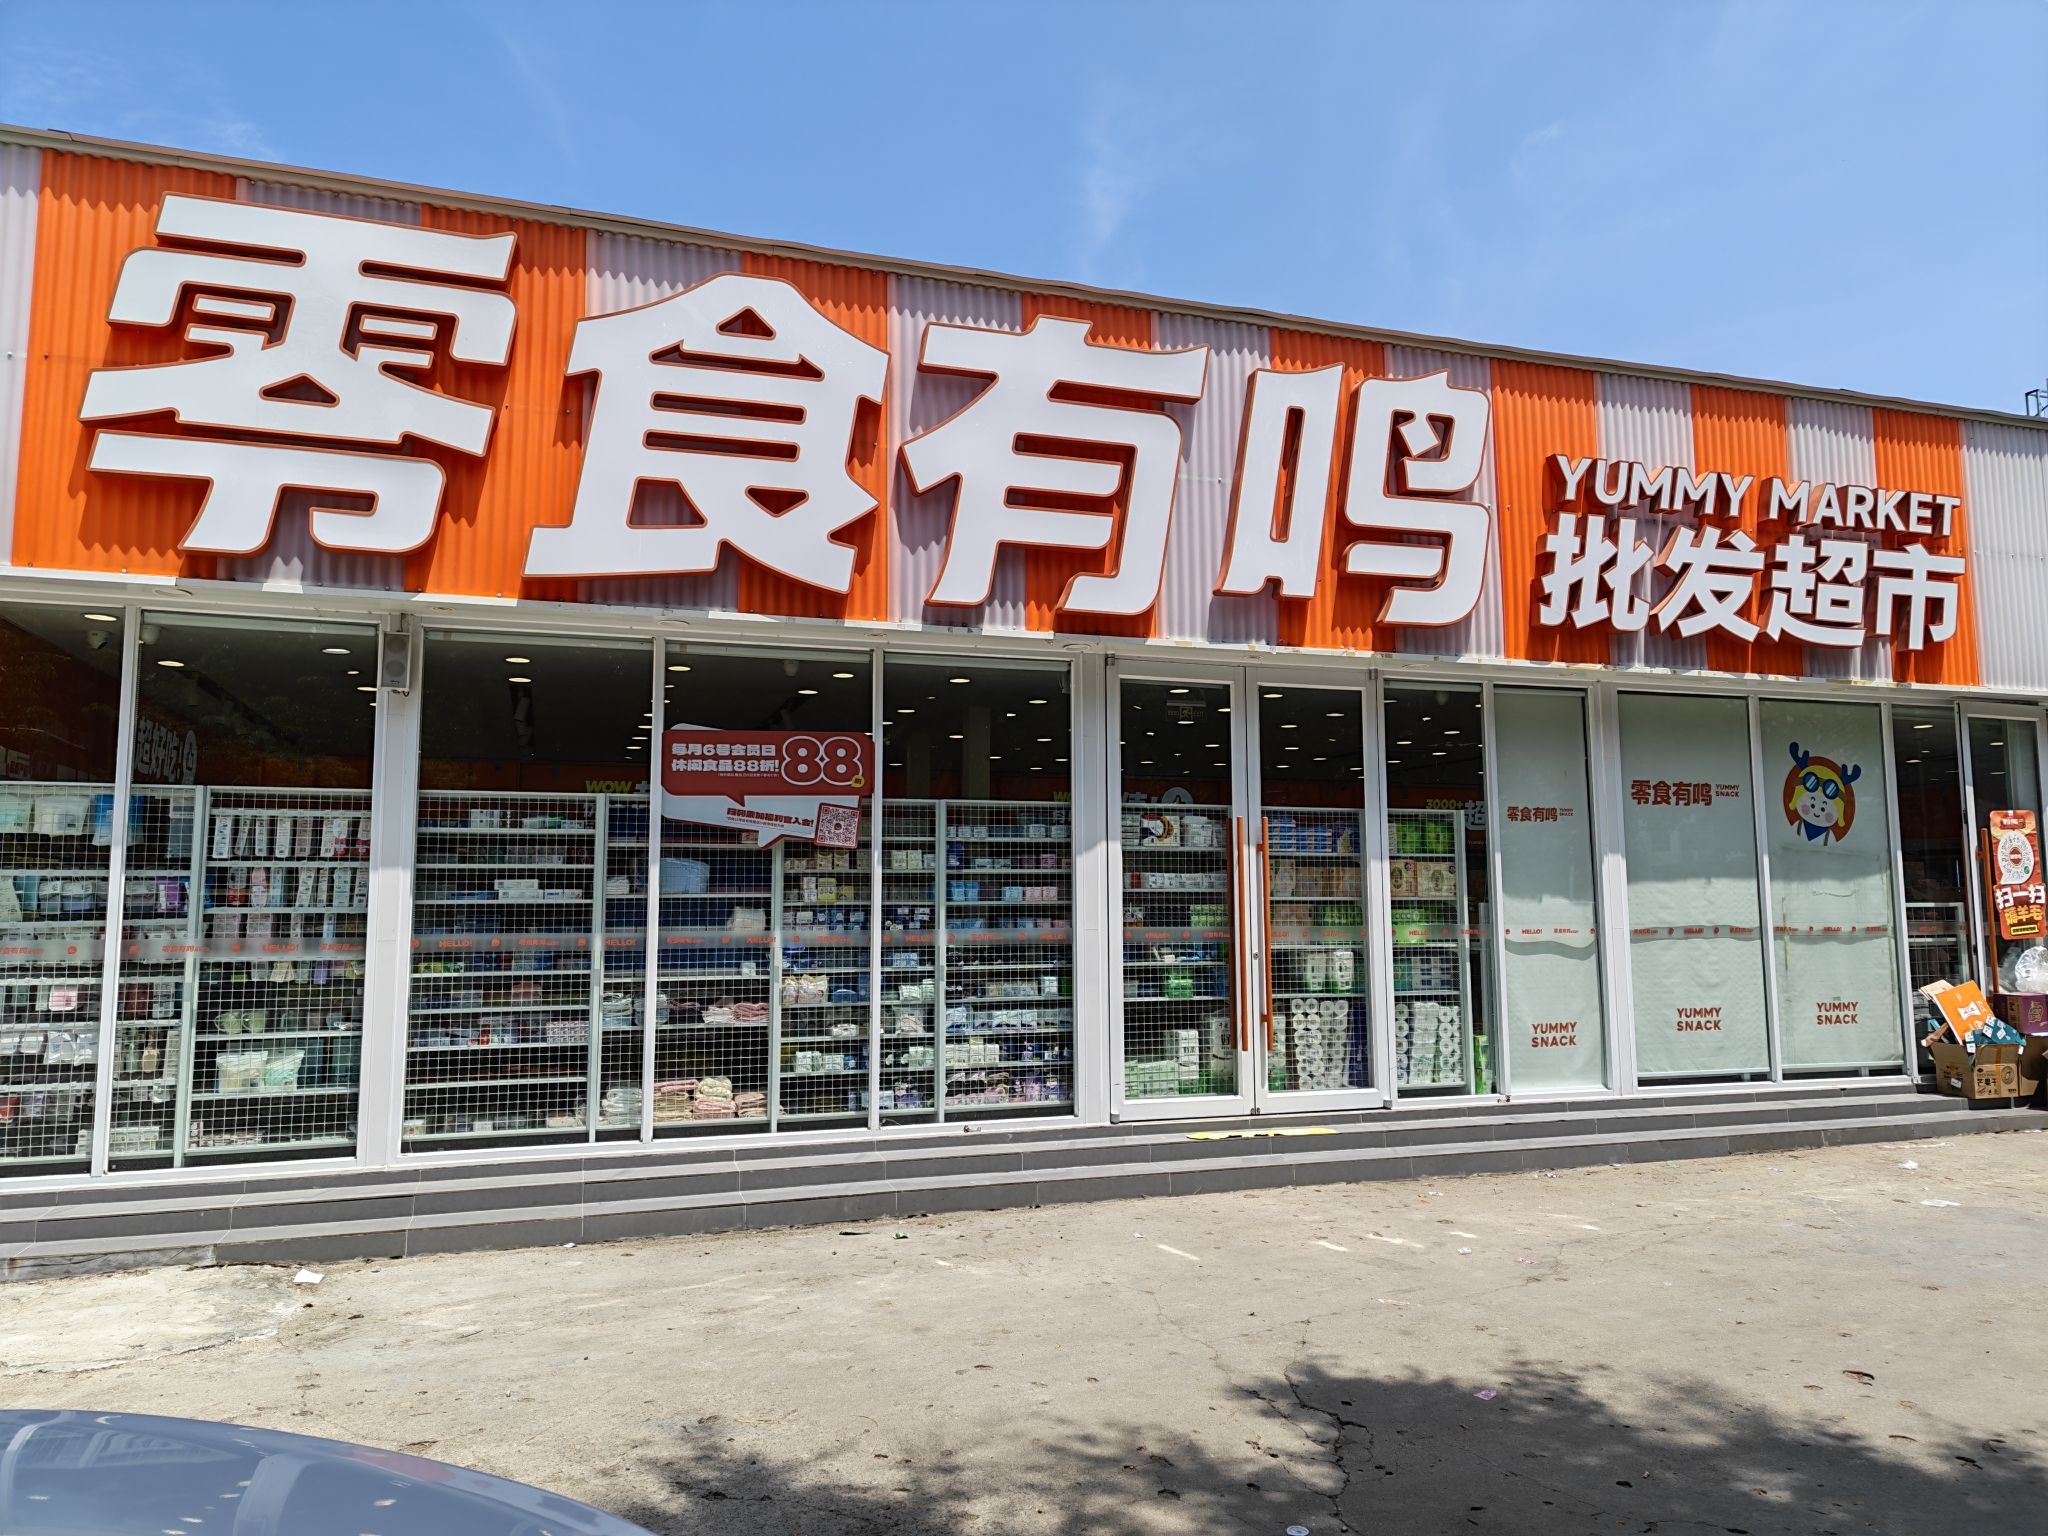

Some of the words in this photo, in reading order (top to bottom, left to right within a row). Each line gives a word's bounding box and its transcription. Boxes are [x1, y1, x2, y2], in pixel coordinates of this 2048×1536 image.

[81, 194, 1491, 627] 零食有鸣
[1556, 453, 1755, 518] YUMMY
[1768, 476, 1961, 538] MARKET
[1539, 512, 1966, 650] 批发超市
[781, 736, 864, 786] 88
[1631, 779, 1713, 806] 零食有鸣
[1715, 790, 1740, 798] SNACK
[1425, 798, 1464, 810] 3000+
[1507, 806, 1558, 822] 零食有鸣
[1995, 884, 2046, 909] 扫一扫
[1519, 928, 1542, 936] HELLO!
[1676, 1006, 1722, 1020] YUMMY
[1816, 1000, 1859, 1013] YUMMY
[1676, 1019, 1722, 1032] SNACK
[1816, 1013, 1858, 1025] SNACK
[1531, 1021, 1578, 1035] YUMMY
[1531, 1035, 1577, 1048] SNACK
